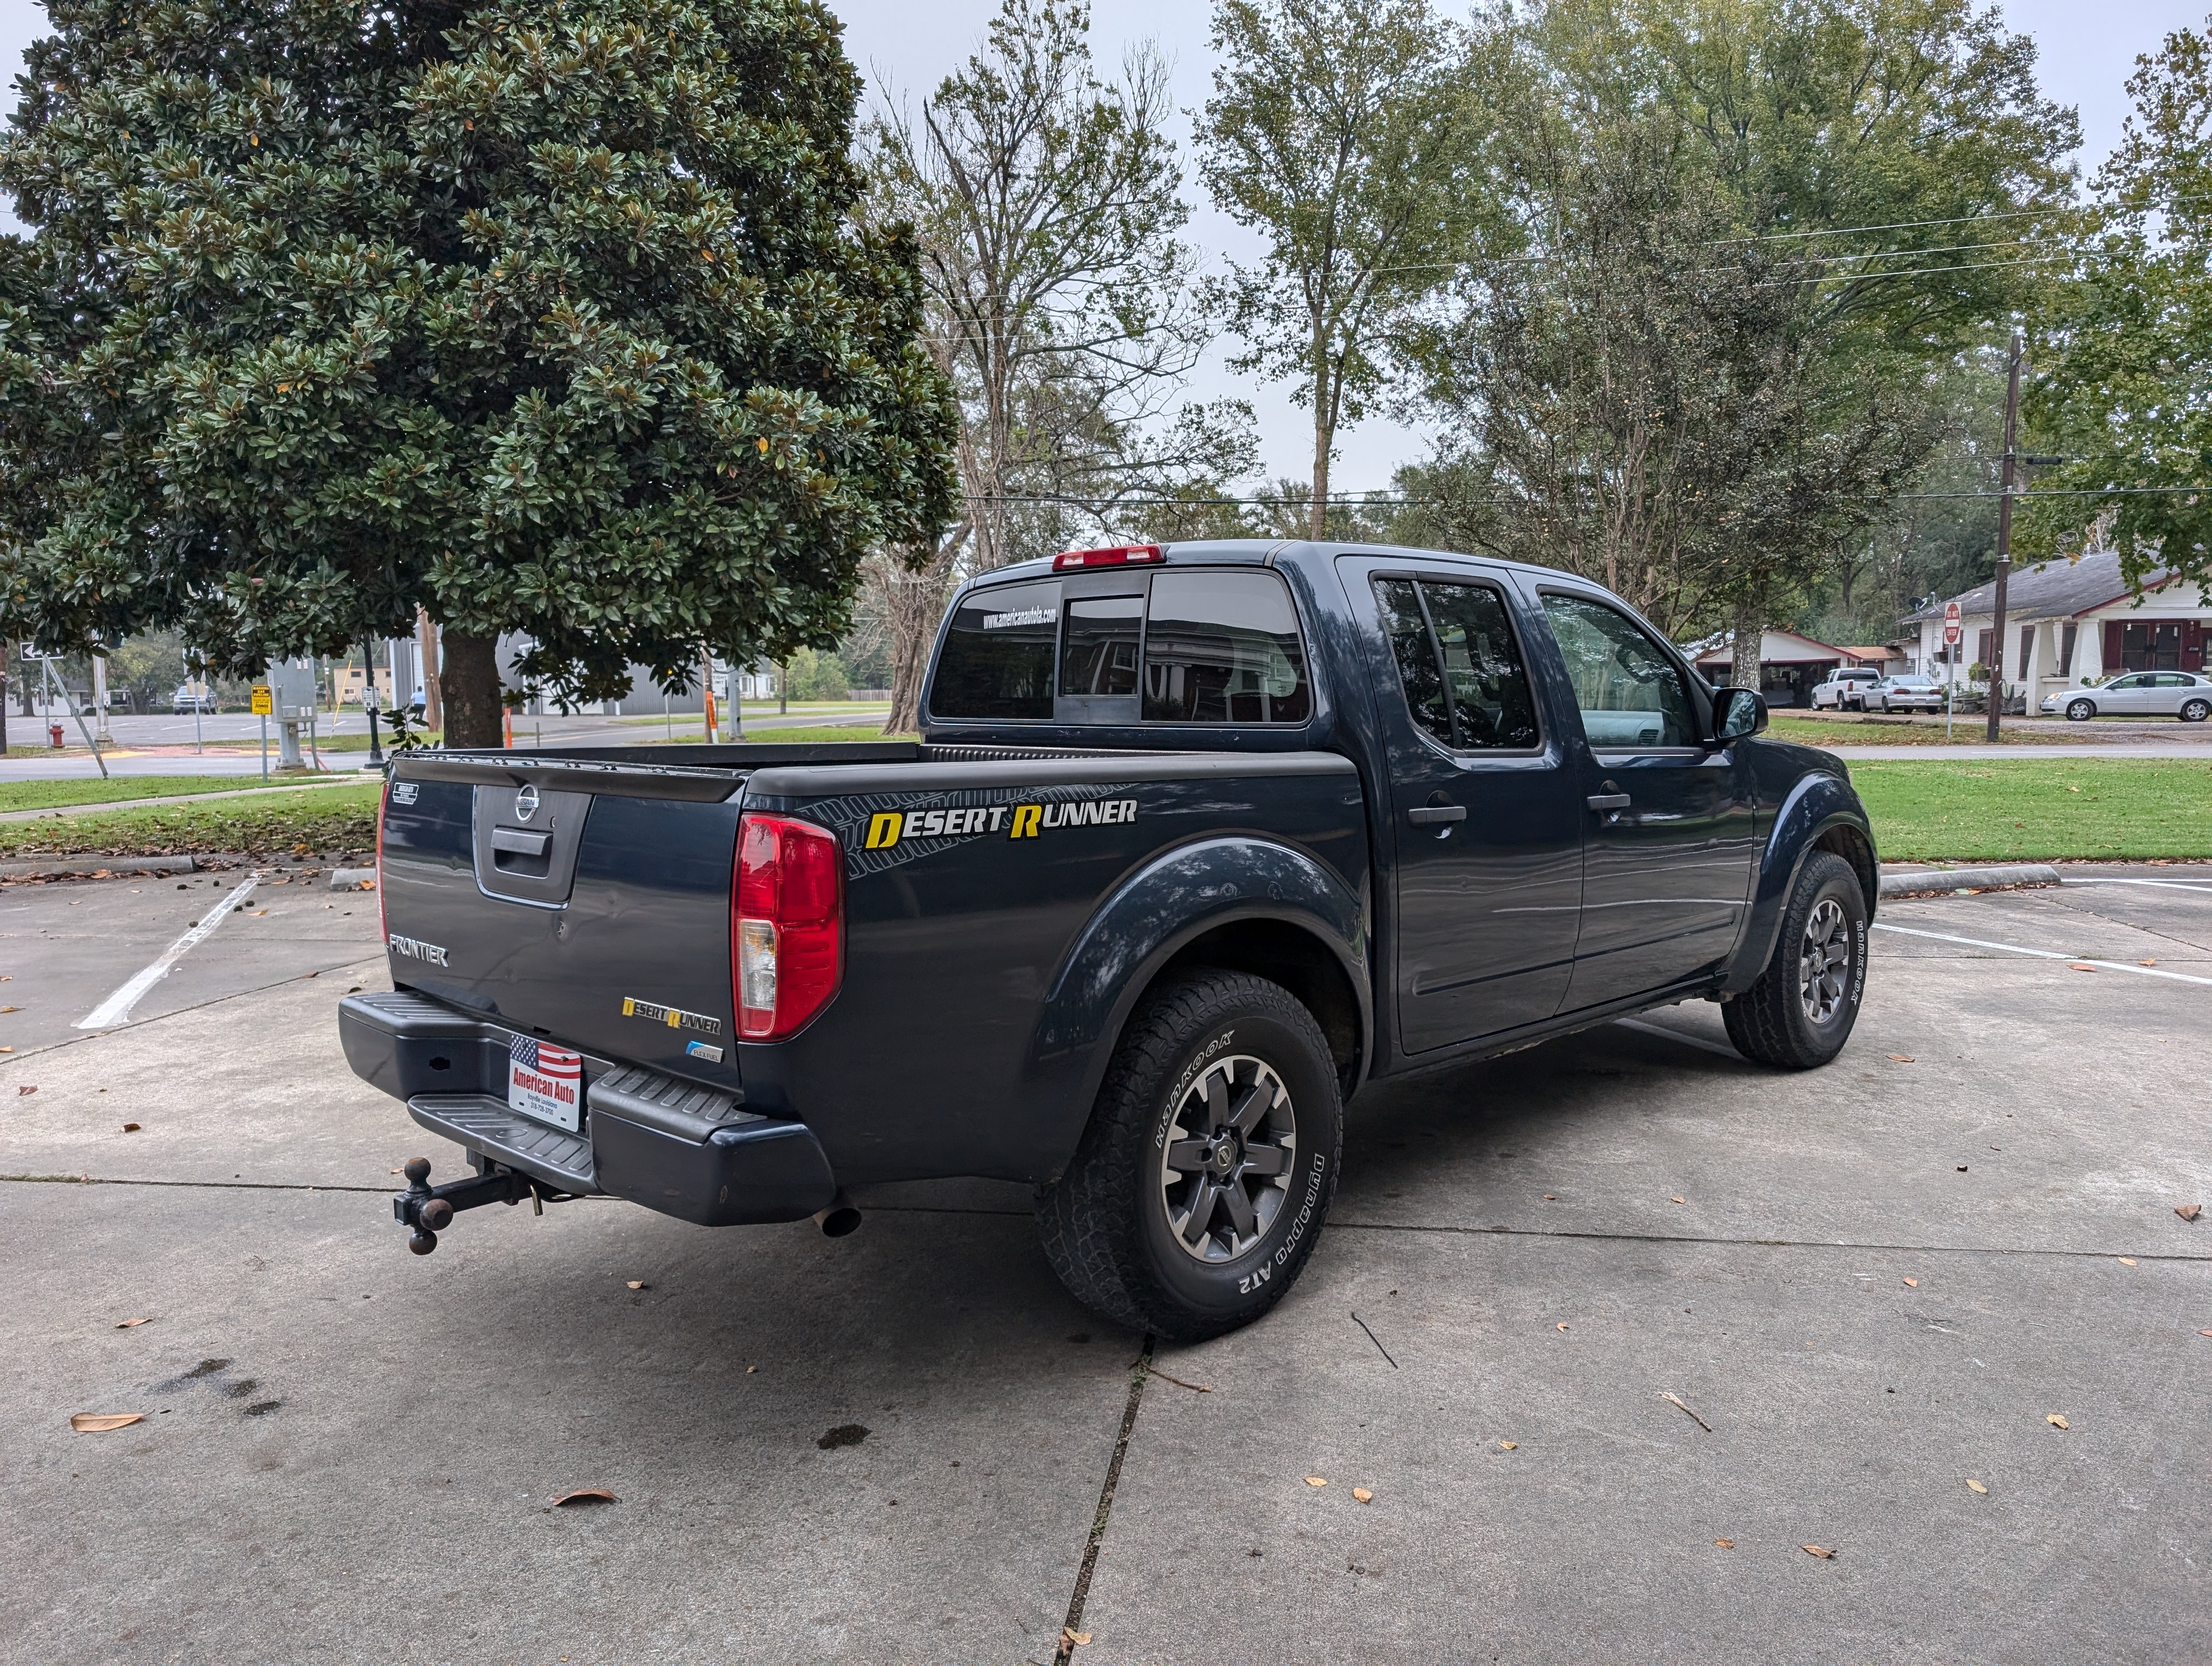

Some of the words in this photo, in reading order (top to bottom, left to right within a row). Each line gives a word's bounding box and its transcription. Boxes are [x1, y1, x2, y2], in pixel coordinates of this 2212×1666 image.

[983, 605, 1056, 630] www.americanautola.com
[865, 806, 1007, 849] DESERT
[1010, 800, 1137, 838] RUNNER
[389, 933, 449, 967] FRONTIER
[622, 997, 667, 1021] DESERT
[667, 1008, 721, 1035] RUNNER
[693, 1049, 706, 1058] FLEX
[706, 1054, 719, 1062] FUEL
[513, 1067, 553, 1098] American
[554, 1080, 575, 1105] Auto
[528, 1093, 541, 1103] Rayville
[541, 1097, 558, 1109] Louisiana
[1276, 1152, 1325, 1265] Dynapro
[1238, 1261, 1271, 1295] AT2
